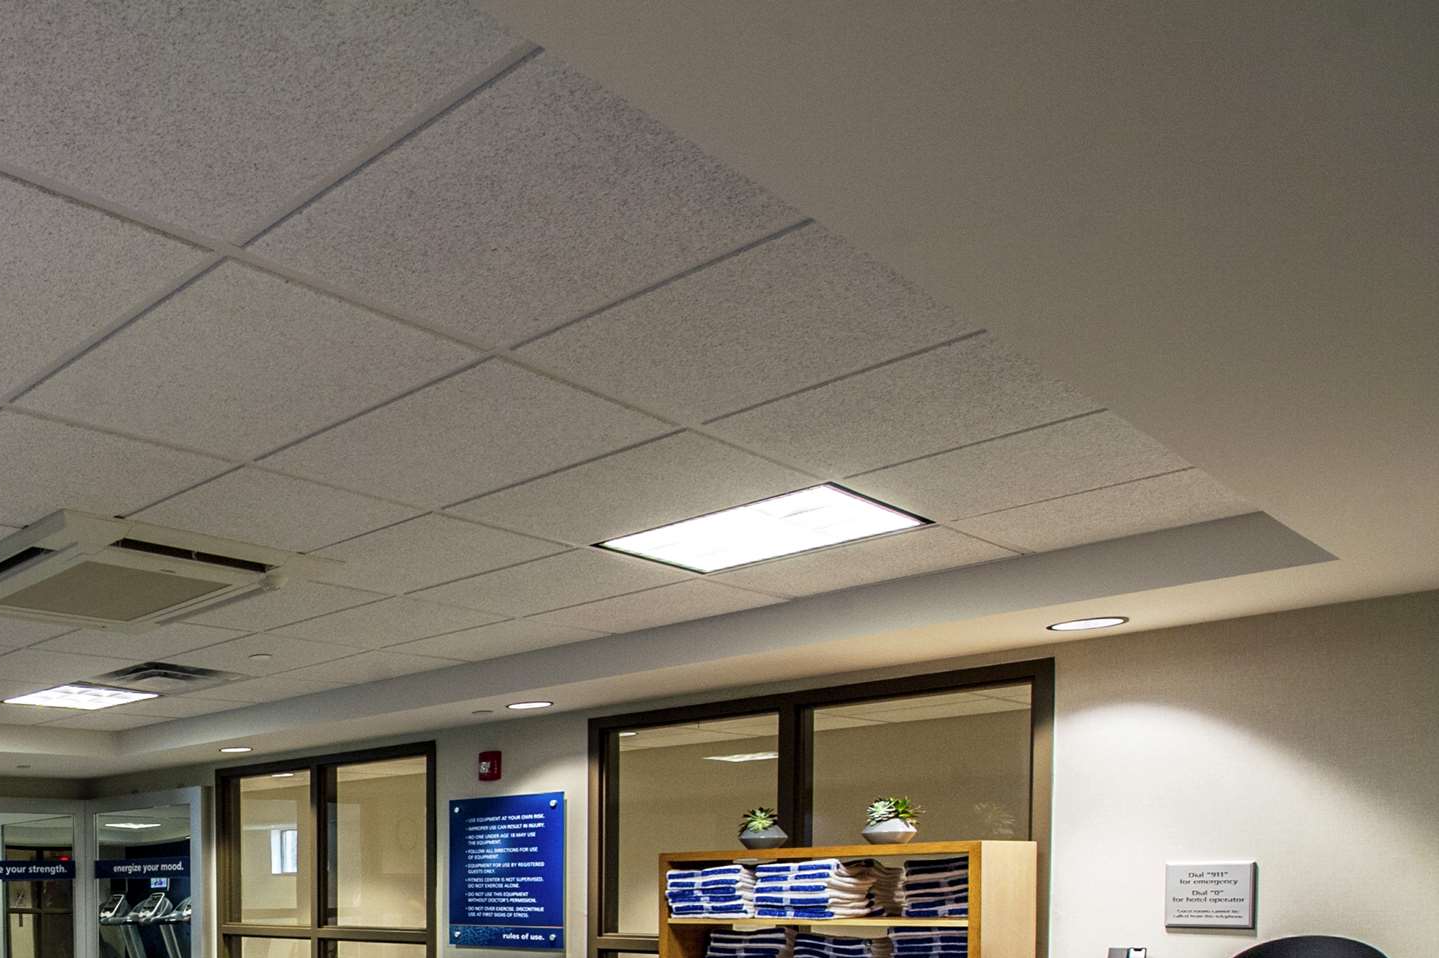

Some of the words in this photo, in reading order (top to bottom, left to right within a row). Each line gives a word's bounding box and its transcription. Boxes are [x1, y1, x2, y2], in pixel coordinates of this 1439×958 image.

[5, 867, 26, 875] your
[29, 865, 67, 875] strength.
[113, 864, 141, 874] energize
[143, 865, 159, 873] your
[161, 861, 184, 870] mood.
